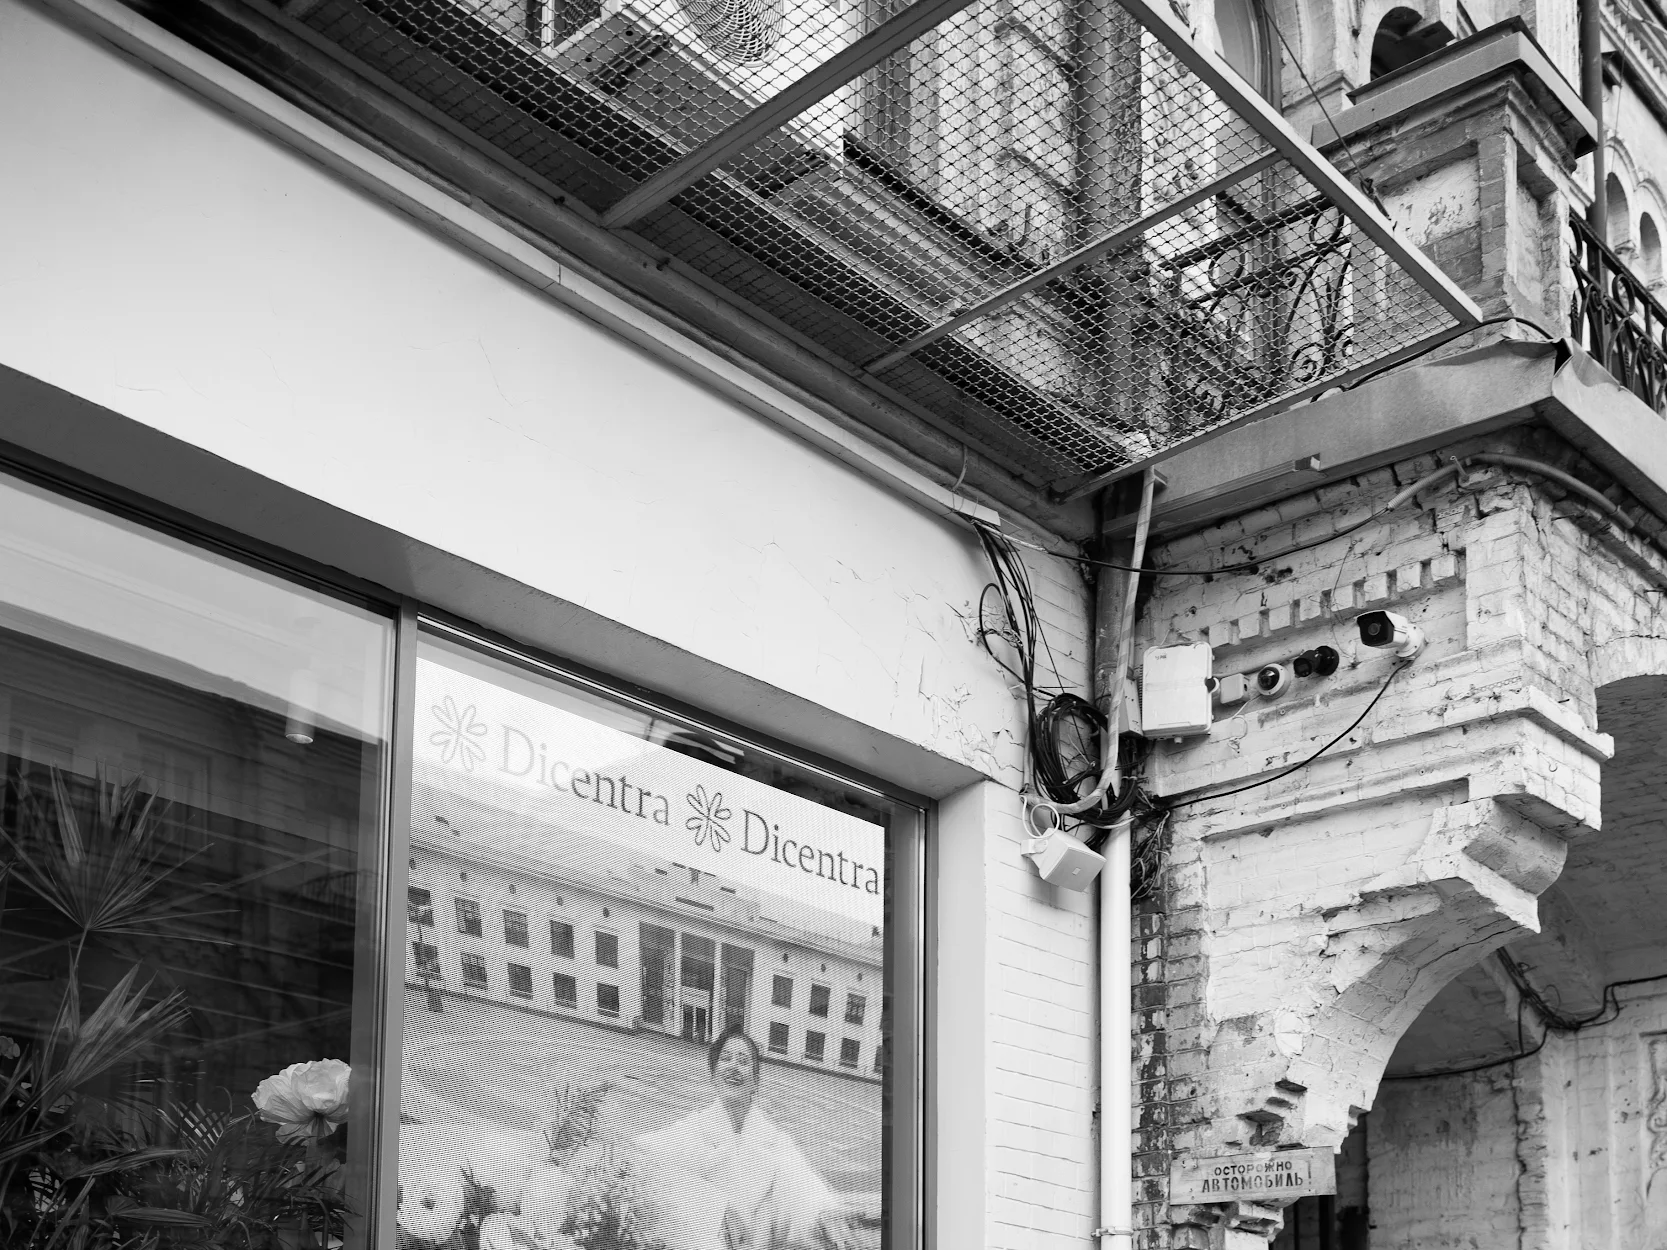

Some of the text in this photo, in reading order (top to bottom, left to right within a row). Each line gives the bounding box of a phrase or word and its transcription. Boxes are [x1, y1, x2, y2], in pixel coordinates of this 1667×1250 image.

[499, 723, 880, 896] Dicentra Dicentra
[1214, 1161, 1293, 1176] ОСТОРОЖНО
